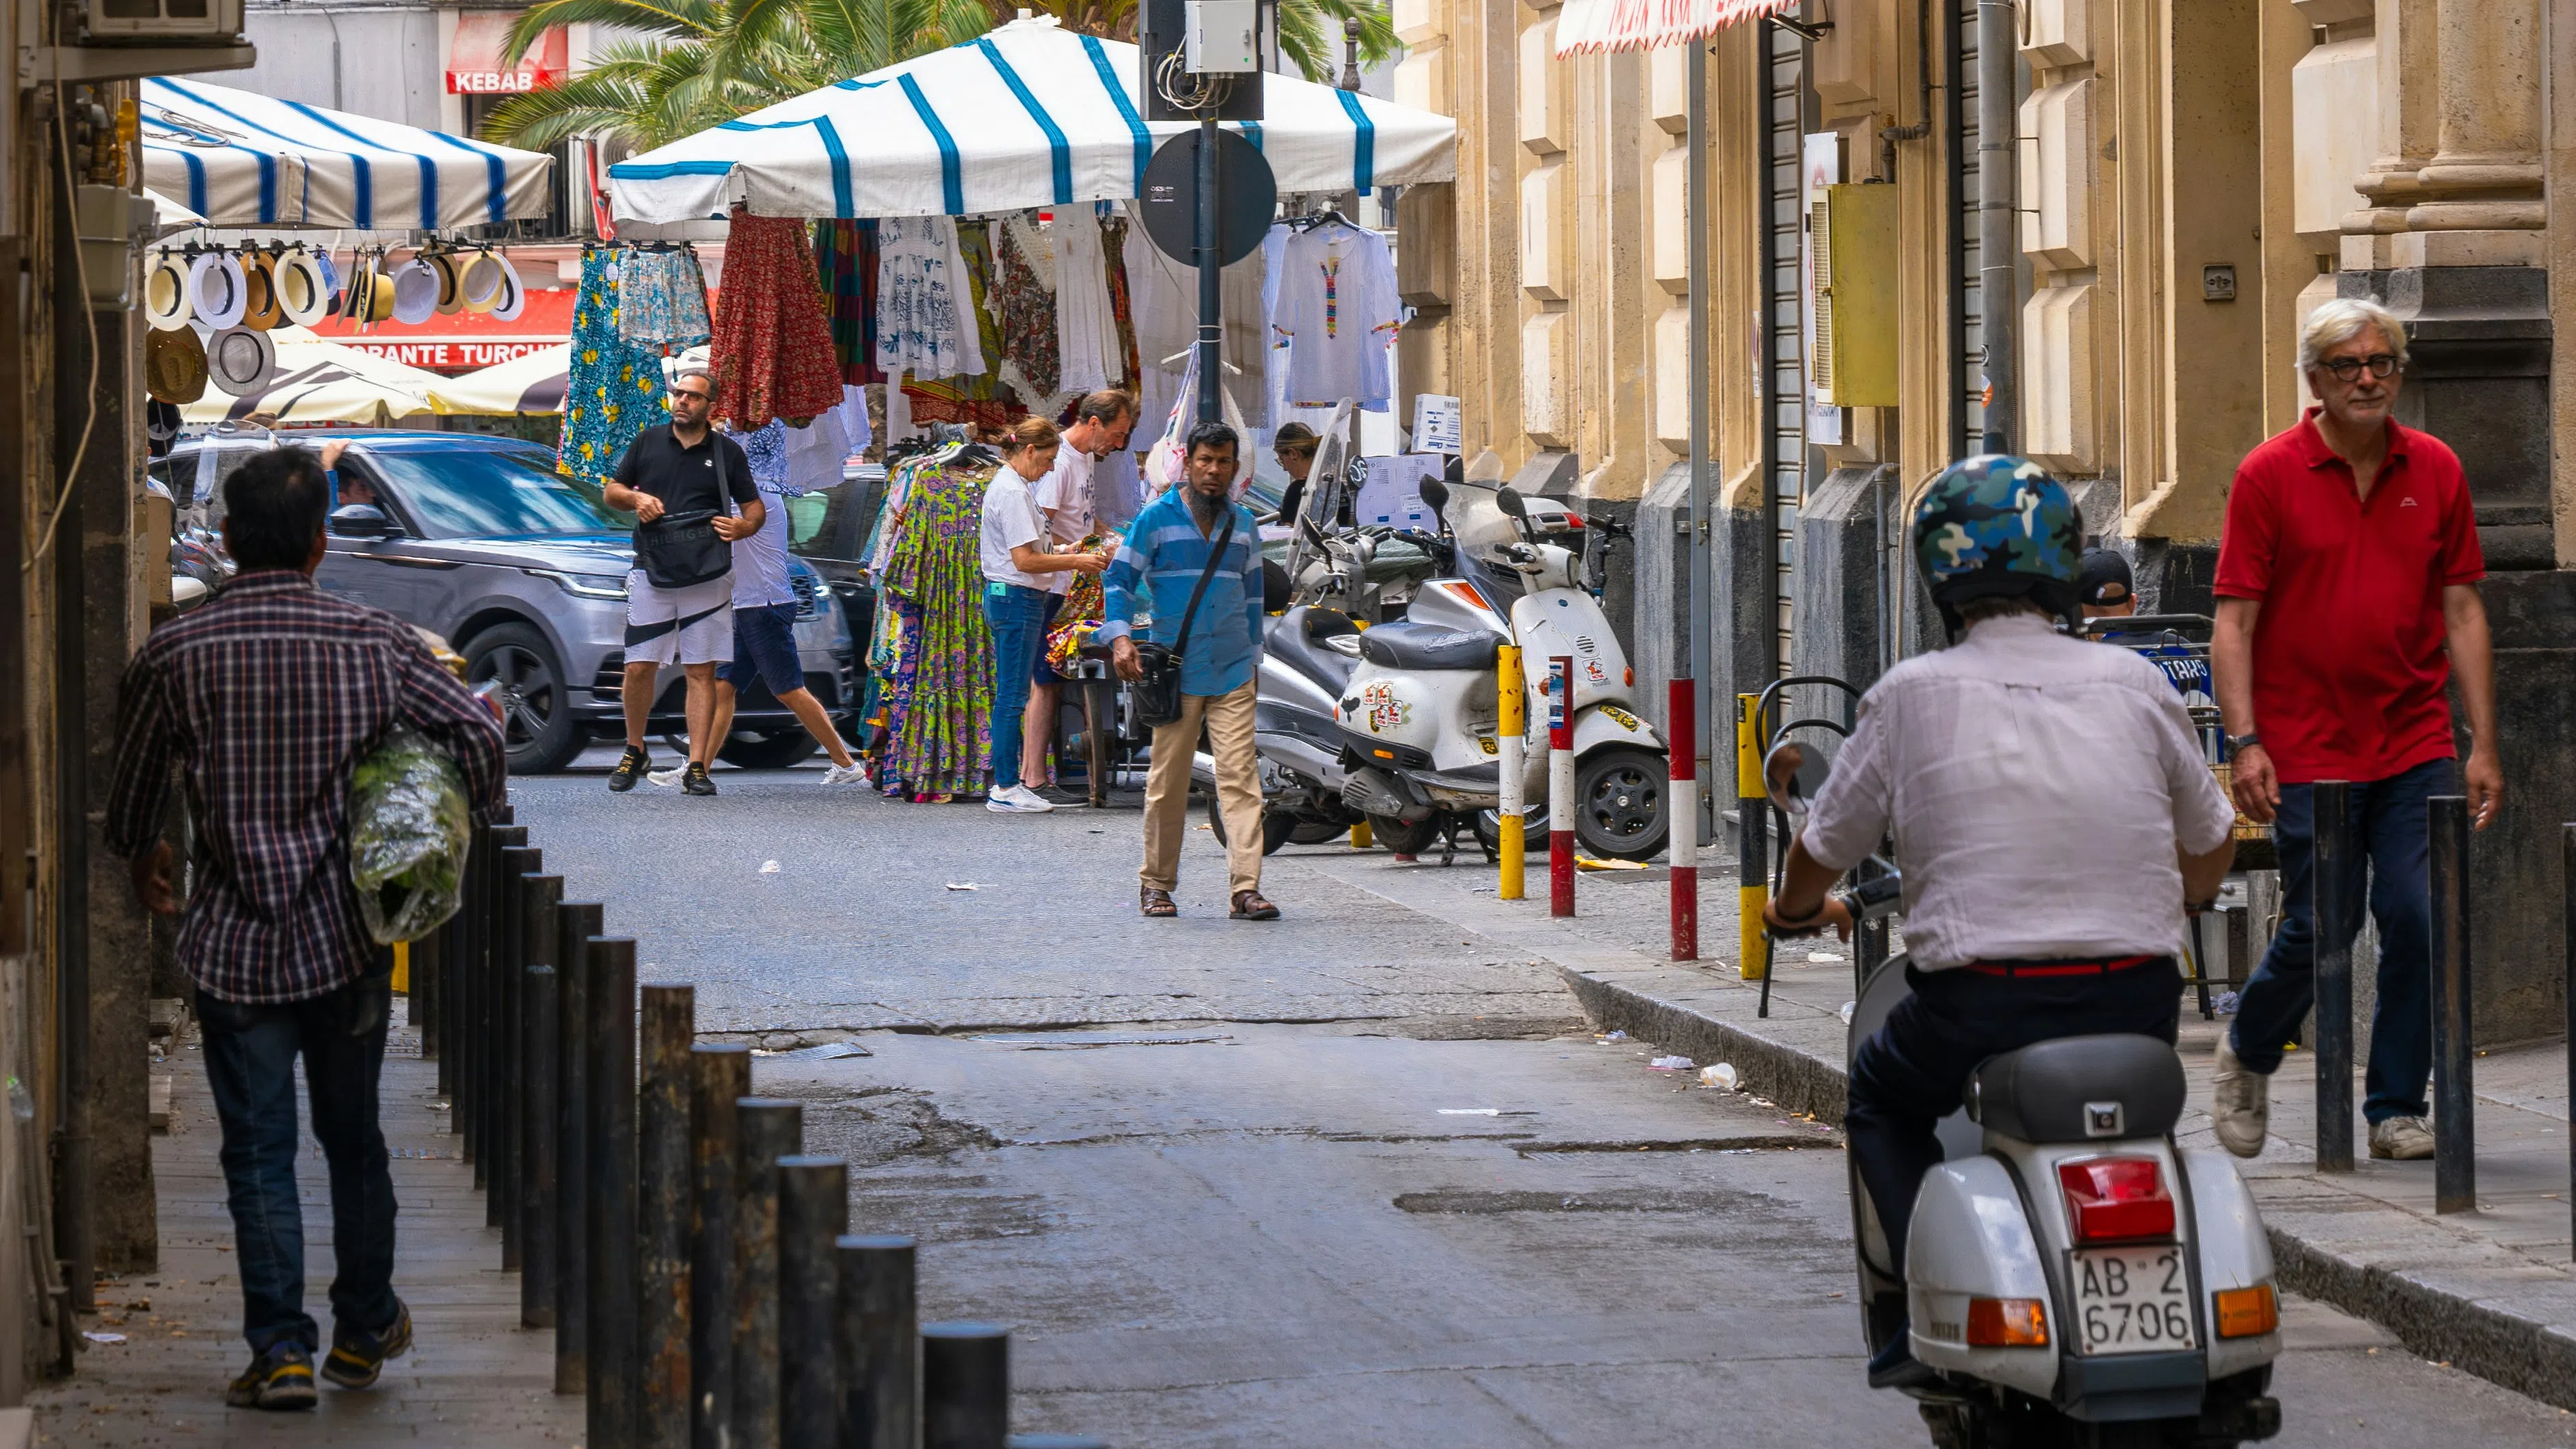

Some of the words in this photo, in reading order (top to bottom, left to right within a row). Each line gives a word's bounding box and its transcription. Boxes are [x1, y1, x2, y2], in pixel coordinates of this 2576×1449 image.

[455, 72, 533, 92] KEBAB
[650, 526, 714, 546] HILFIGER
[2082, 1257, 2129, 1297] AB
[2157, 1255, 2184, 1294] 2
[2086, 1301, 2187, 1344] 6706
